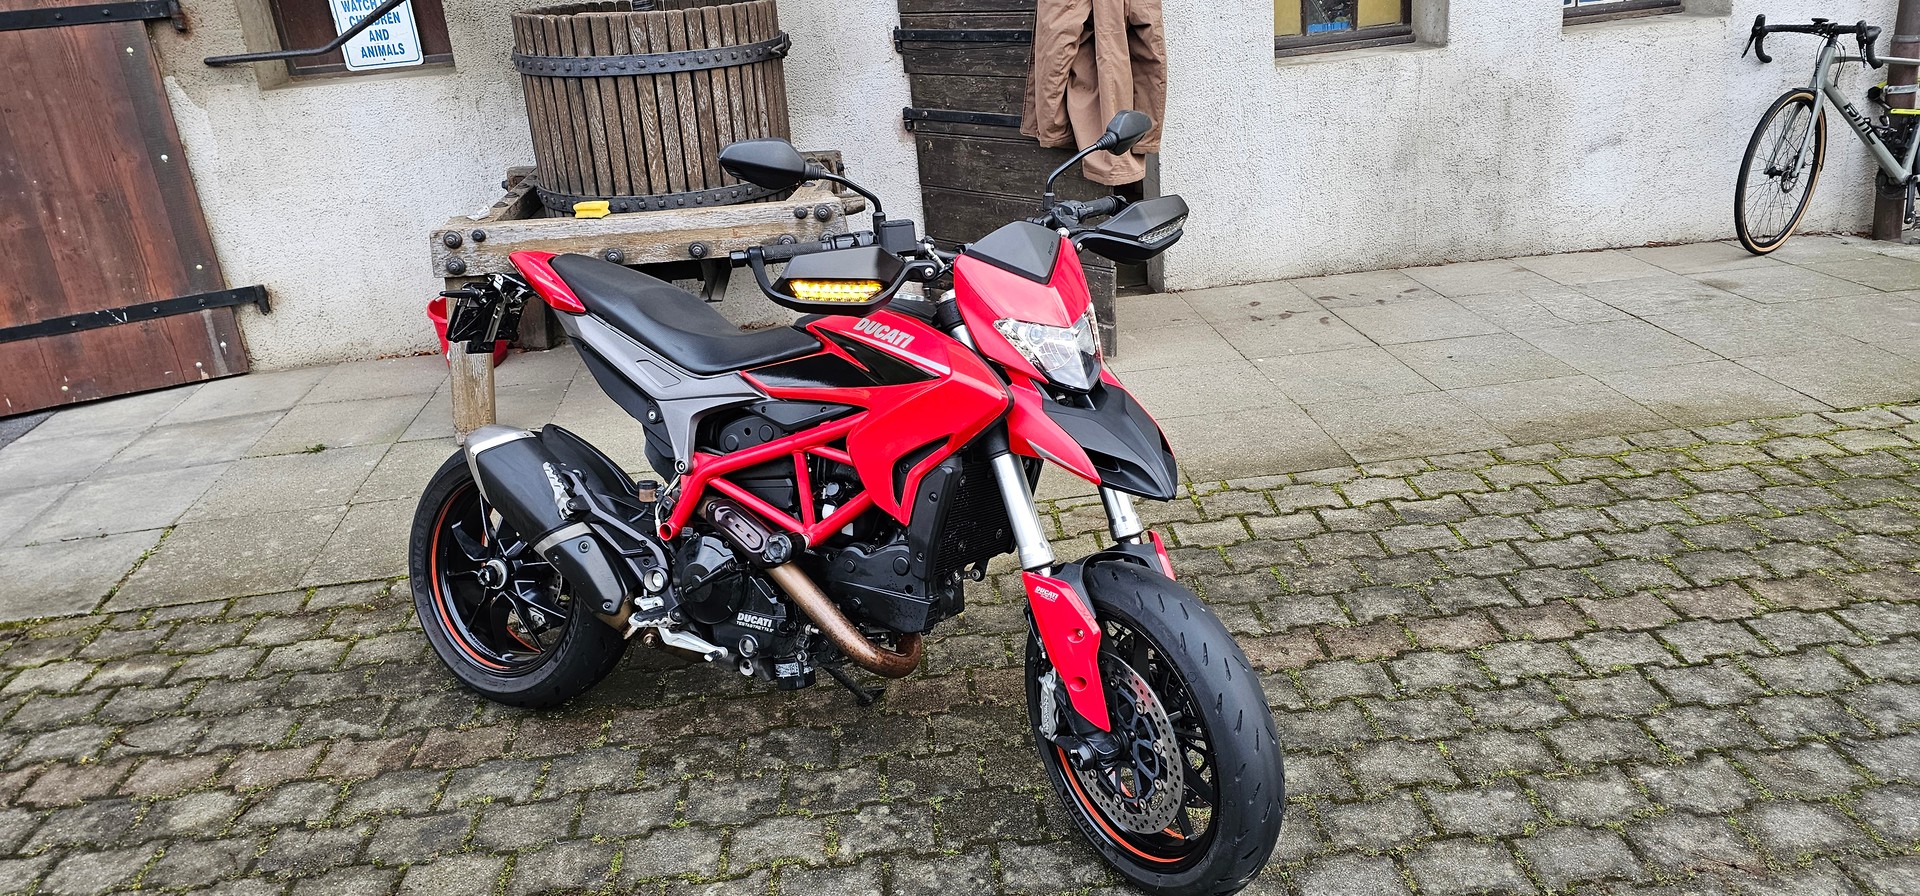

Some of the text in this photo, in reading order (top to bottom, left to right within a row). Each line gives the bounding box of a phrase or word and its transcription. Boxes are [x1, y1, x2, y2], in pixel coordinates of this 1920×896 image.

[340, 0, 379, 13] WATCH
[348, 11, 401, 27] CHDREN
[369, 28, 390, 42] AND
[361, 42, 406, 59] ANIMALS
[853, 317, 915, 349] DUCATI
[1034, 585, 1059, 600] DUCATI
[737, 612, 772, 628] DUCATI
